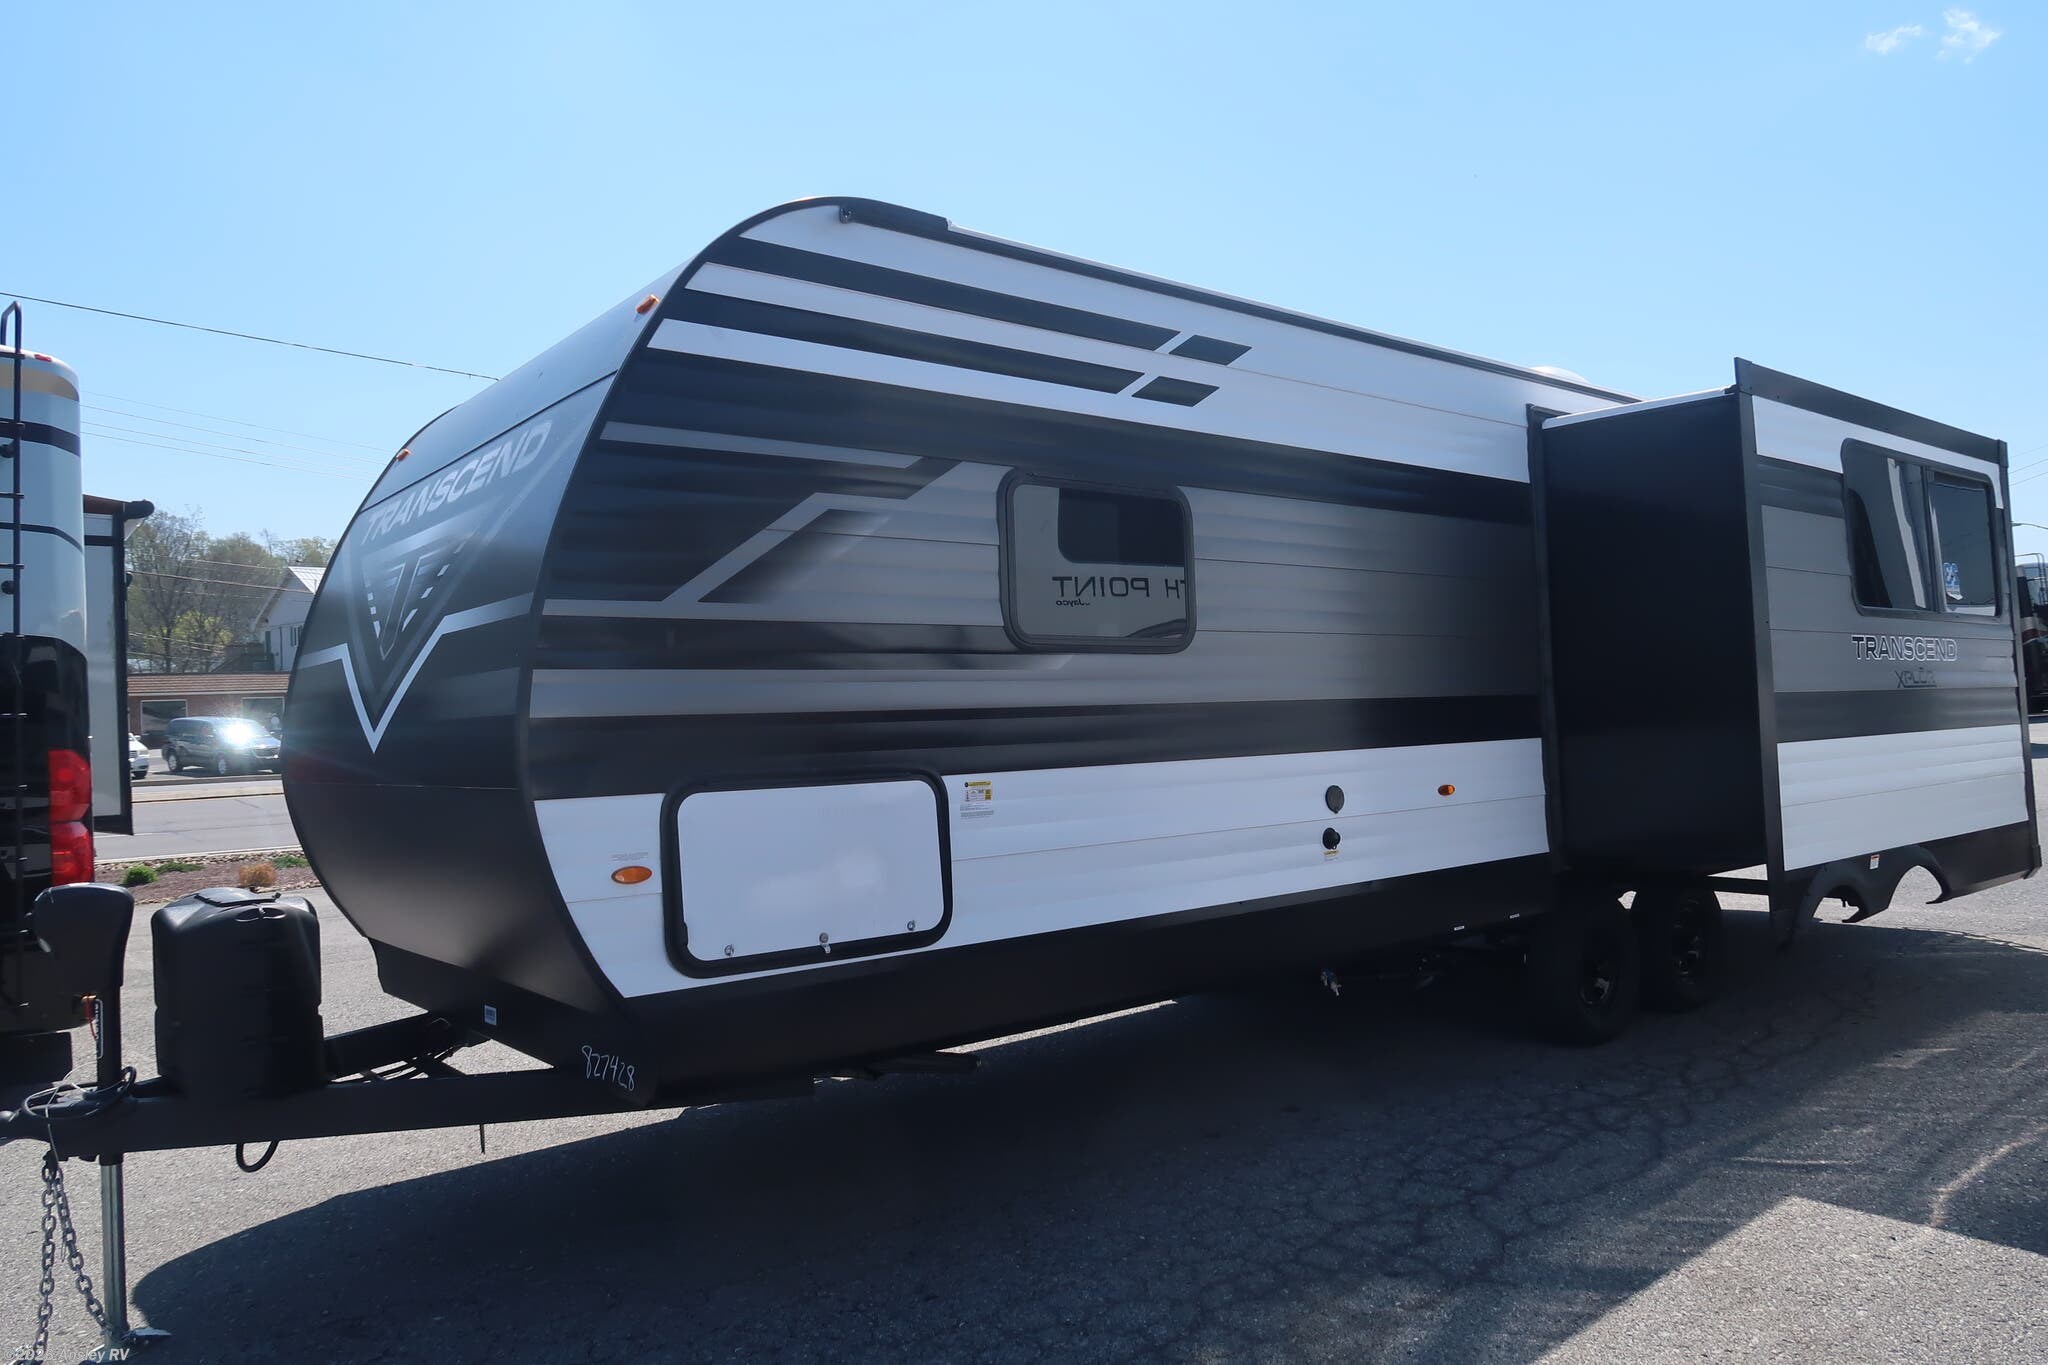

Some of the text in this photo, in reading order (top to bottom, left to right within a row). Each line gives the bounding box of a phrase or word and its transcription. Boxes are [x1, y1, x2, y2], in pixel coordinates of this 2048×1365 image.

[361, 420, 552, 545] TRANSCEND
[1851, 635, 1958, 662] TRANSCEND
[581, 1045, 635, 1091] 827428
